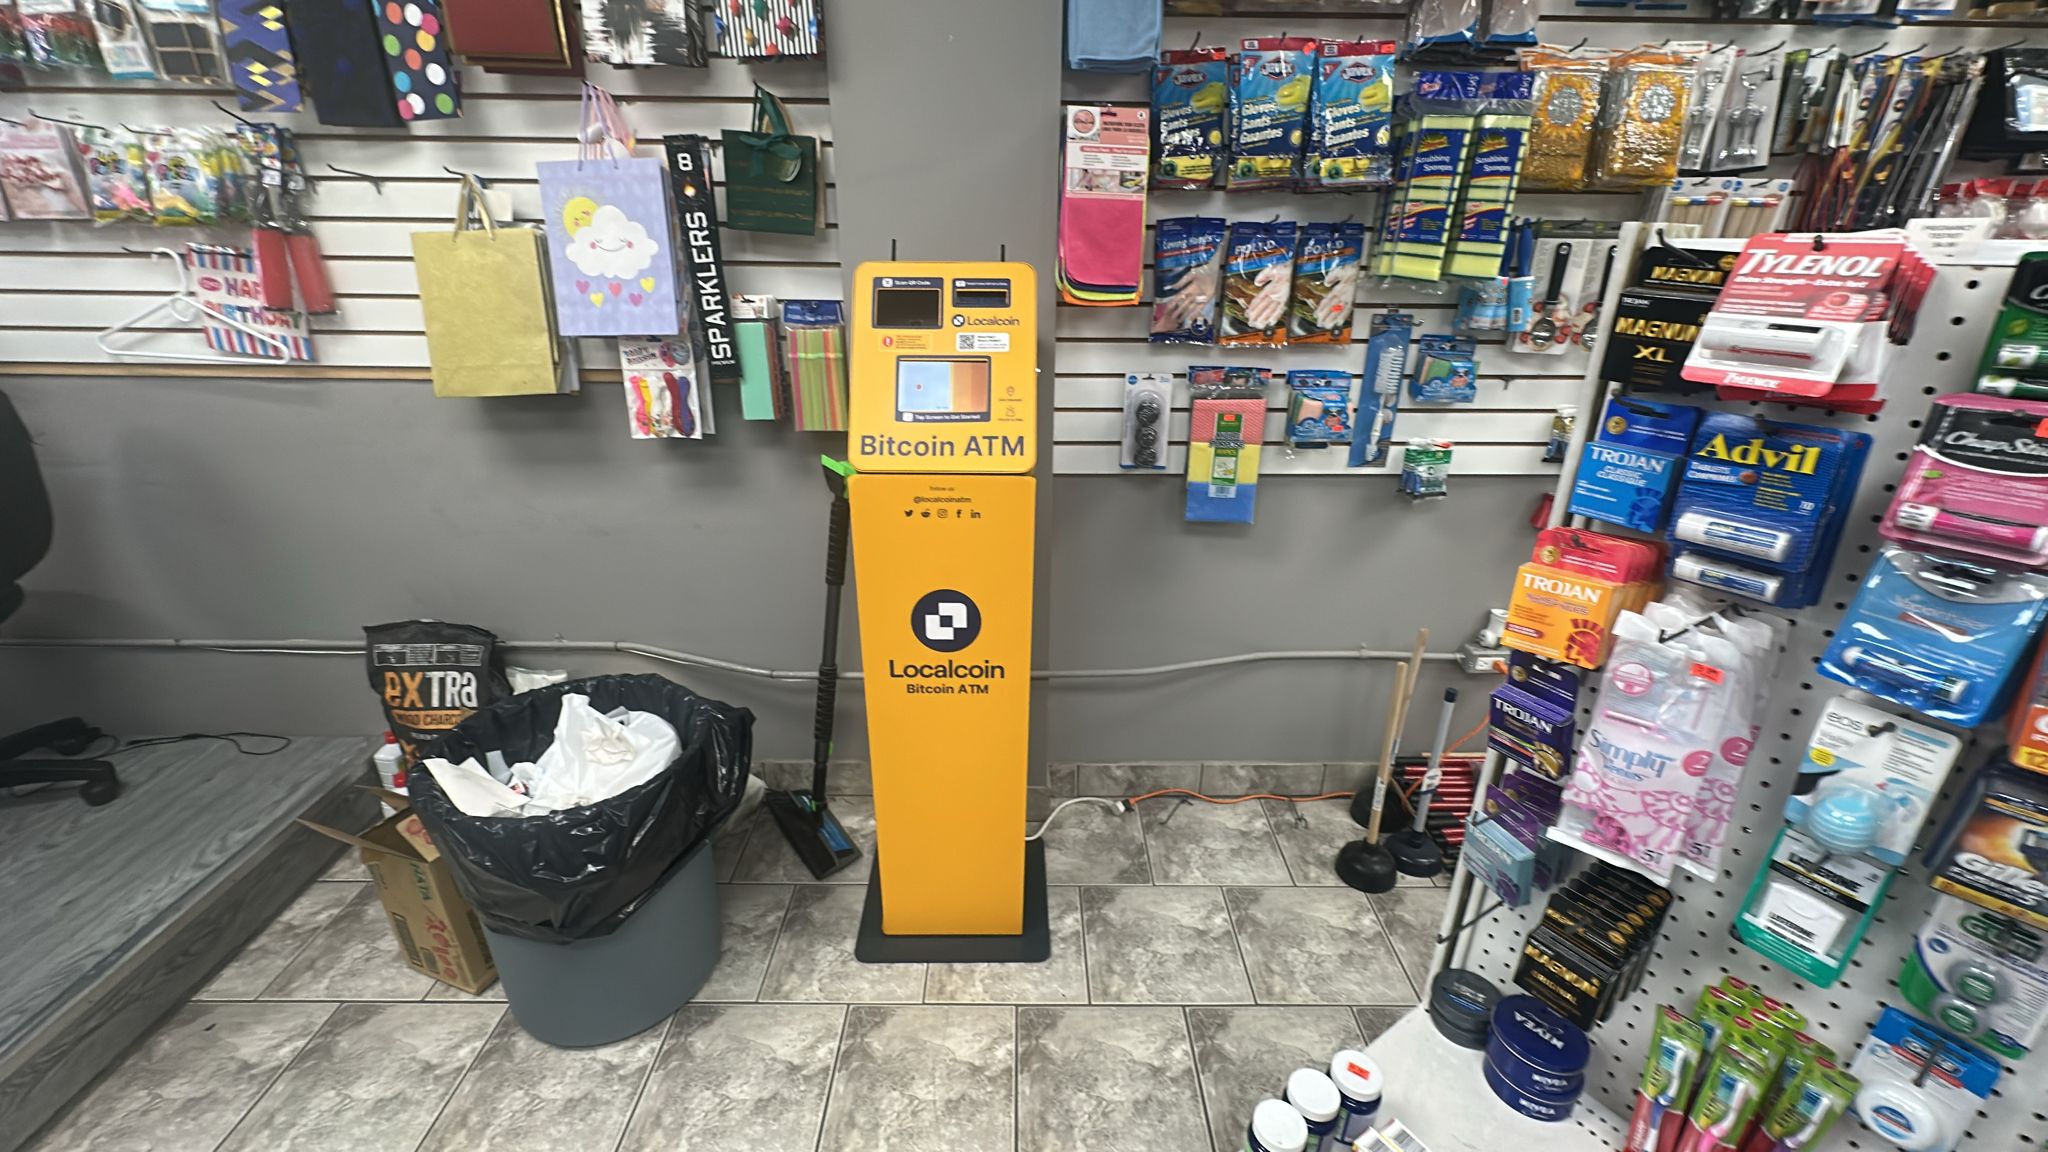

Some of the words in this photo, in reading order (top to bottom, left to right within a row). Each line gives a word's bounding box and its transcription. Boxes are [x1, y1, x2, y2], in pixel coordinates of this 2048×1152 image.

[676, 152, 694, 172] 8
[1736, 249, 1894, 278] TYLENOL
[685, 210, 733, 361] SPARKLERS
[1651, 265, 1725, 286] MAGNUM
[967, 315, 1021, 327] Localcoin
[1614, 316, 1702, 342] MAGNUM
[1632, 344, 1675, 363] XL
[860, 434, 955, 457] Bitcoin
[963, 435, 1025, 457] ATM
[1695, 432, 1822, 475] Advil
[1590, 446, 1666, 473] TROJAN
[913, 496, 972, 504] @localcoinatm
[1522, 573, 1604, 604] TROJAN
[889, 659, 1005, 679] Localcoin
[906, 683, 955, 694] Bitcoin
[958, 684, 989, 694] ATM
[1492, 697, 1553, 734] TROJAN
[1826, 711, 1864, 731] eos
[1589, 728, 1678, 779] Simply
[1787, 852, 1864, 894] LISERINE
[1513, 1010, 1566, 1050] NIVEA
[1531, 1072, 1569, 1087] NIVEA
[1518, 1097, 1556, 1116] NIVEA
